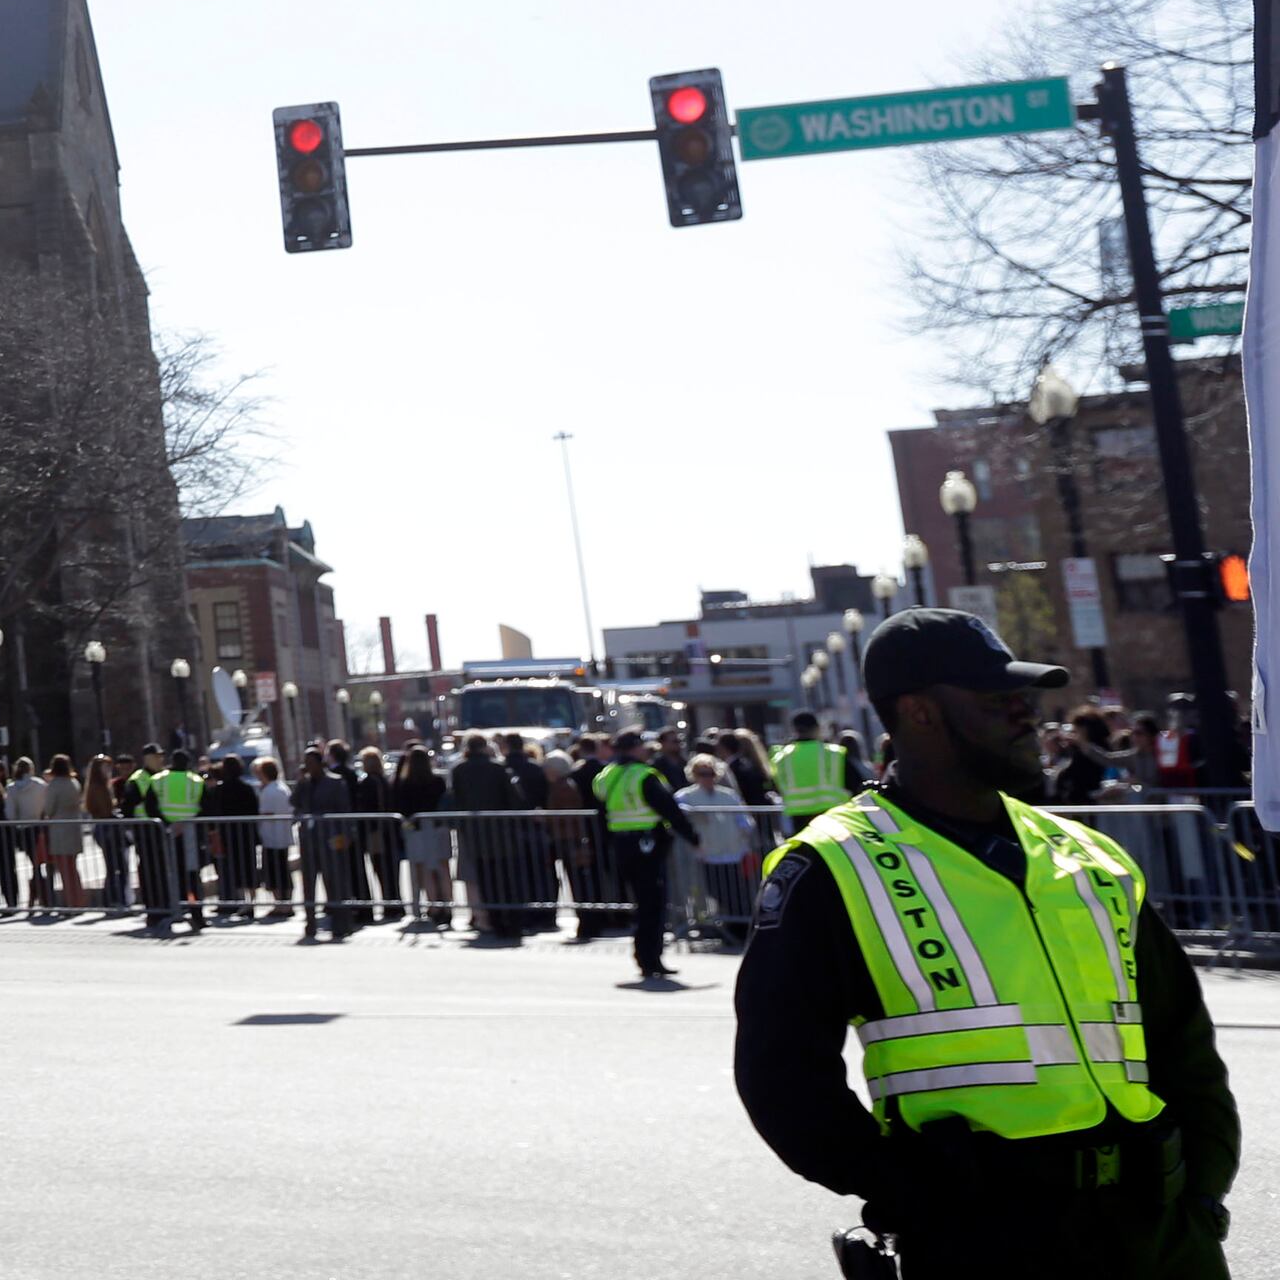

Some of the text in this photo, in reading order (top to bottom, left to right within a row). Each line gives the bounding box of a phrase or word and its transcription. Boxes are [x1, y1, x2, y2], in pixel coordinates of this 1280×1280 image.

[799, 89, 1050, 144] WASHINGTON ST
[861, 830, 962, 992] BOSTON
